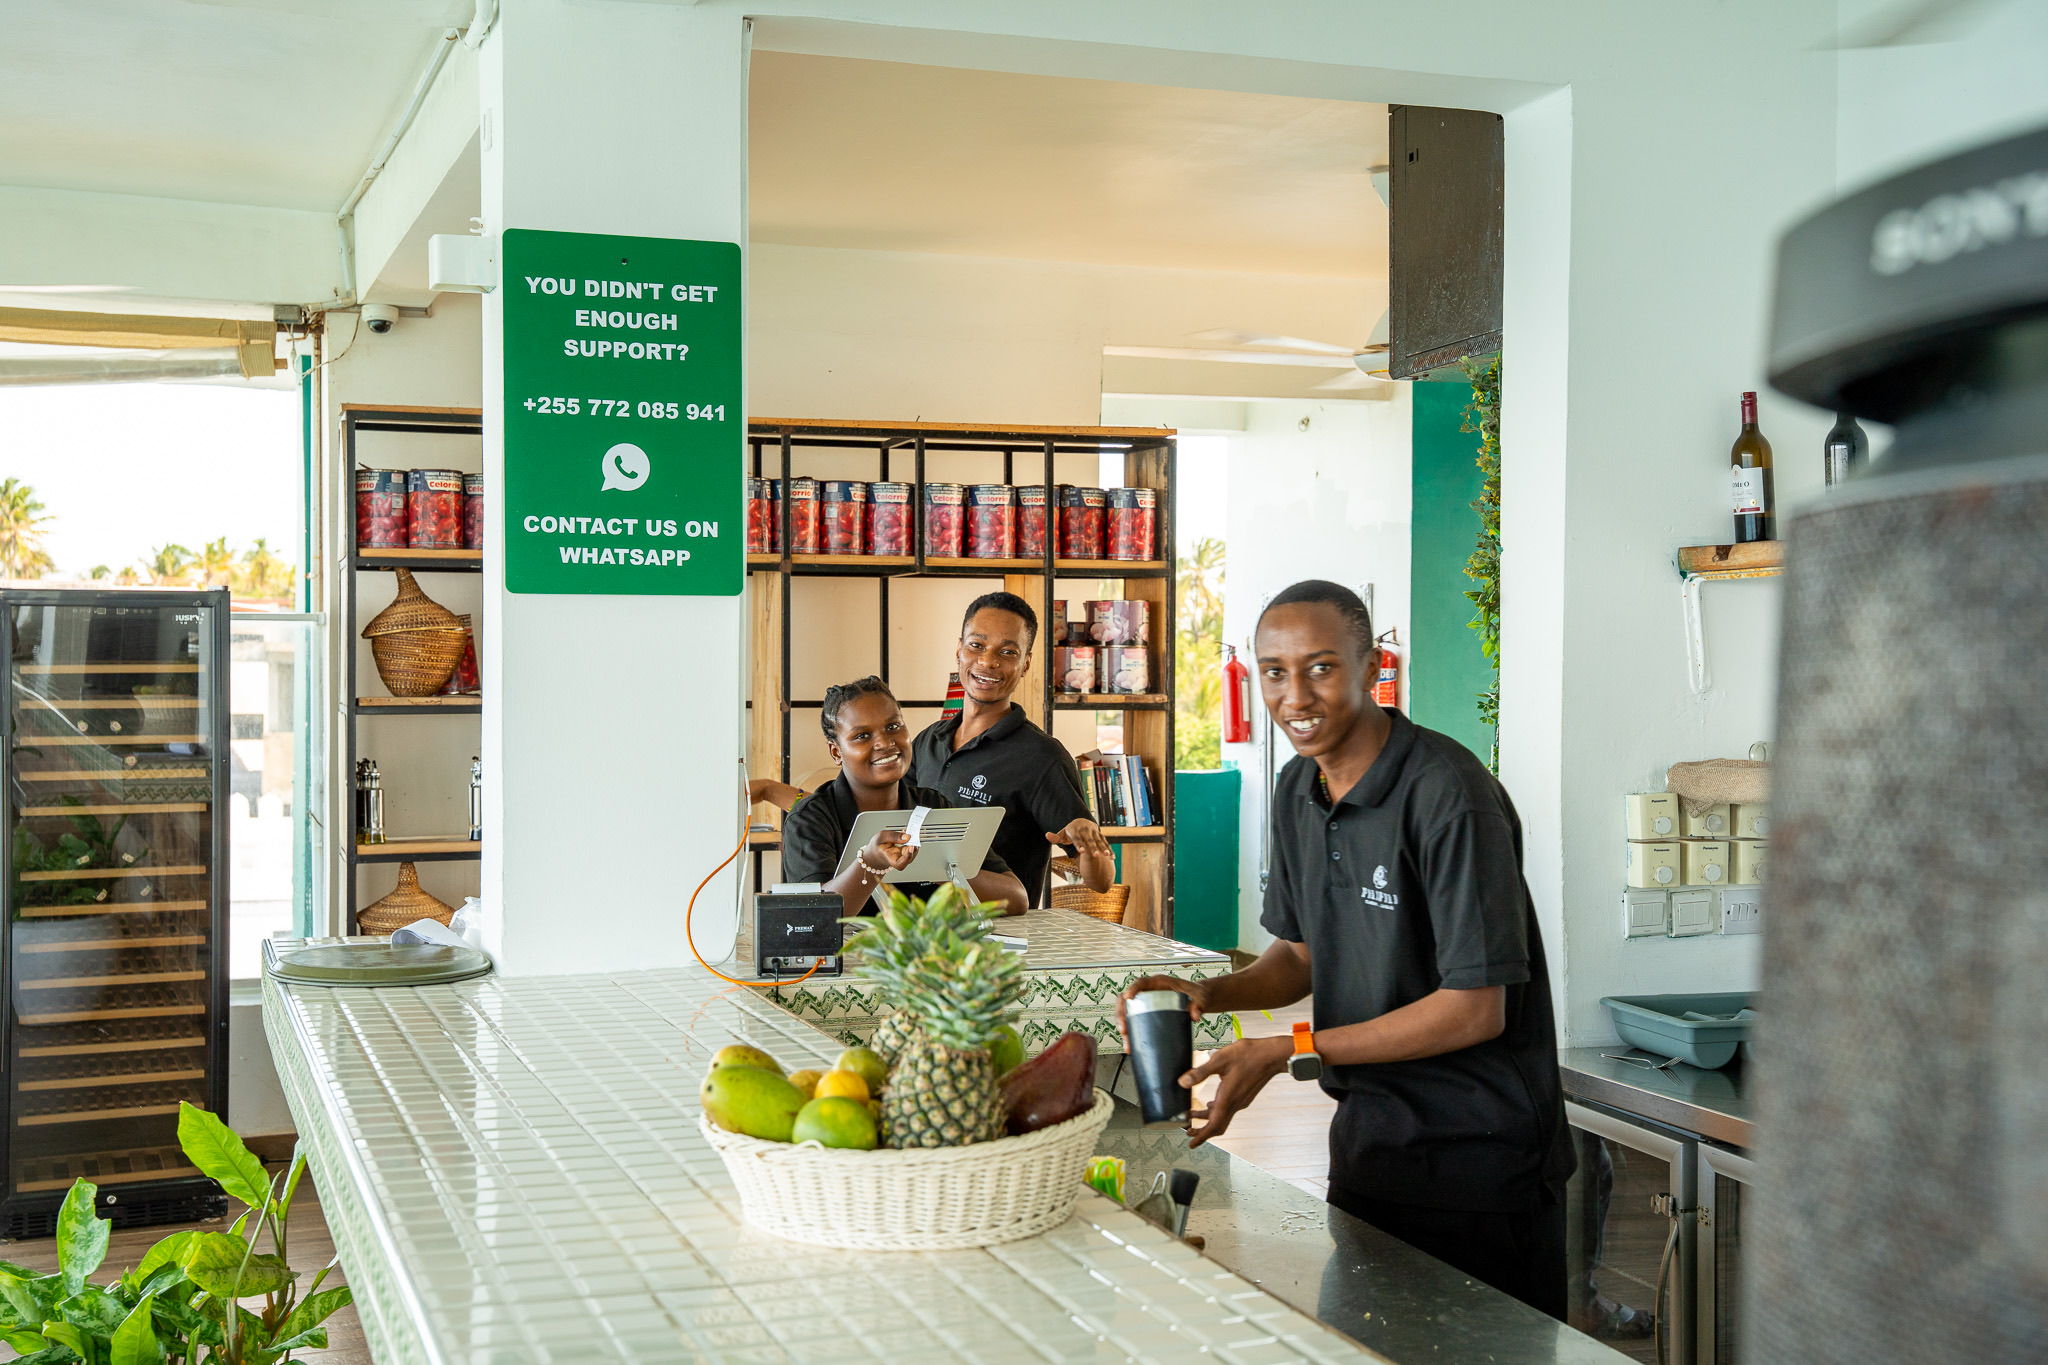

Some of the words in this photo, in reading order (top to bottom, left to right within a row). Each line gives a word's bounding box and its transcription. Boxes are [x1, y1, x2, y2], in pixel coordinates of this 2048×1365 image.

[524, 276, 576, 296] YOU
[584, 279, 664, 300] DIDN'T
[671, 284, 718, 303] GET
[575, 309, 678, 331] ENOUGH
[563, 339, 690, 361] SUPPORT?
[523, 396, 581, 415] +255
[587, 398, 630, 418] 772
[637, 401, 679, 420] 085
[686, 403, 725, 422] 941
[876, 493, 907, 501] Celorrio
[523, 515, 639, 536] CONTACT
[645, 519, 678, 537] US
[684, 520, 719, 538] ON
[559, 546, 691, 567] WHATSAPP
[957, 786, 992, 802] PILIPILI
